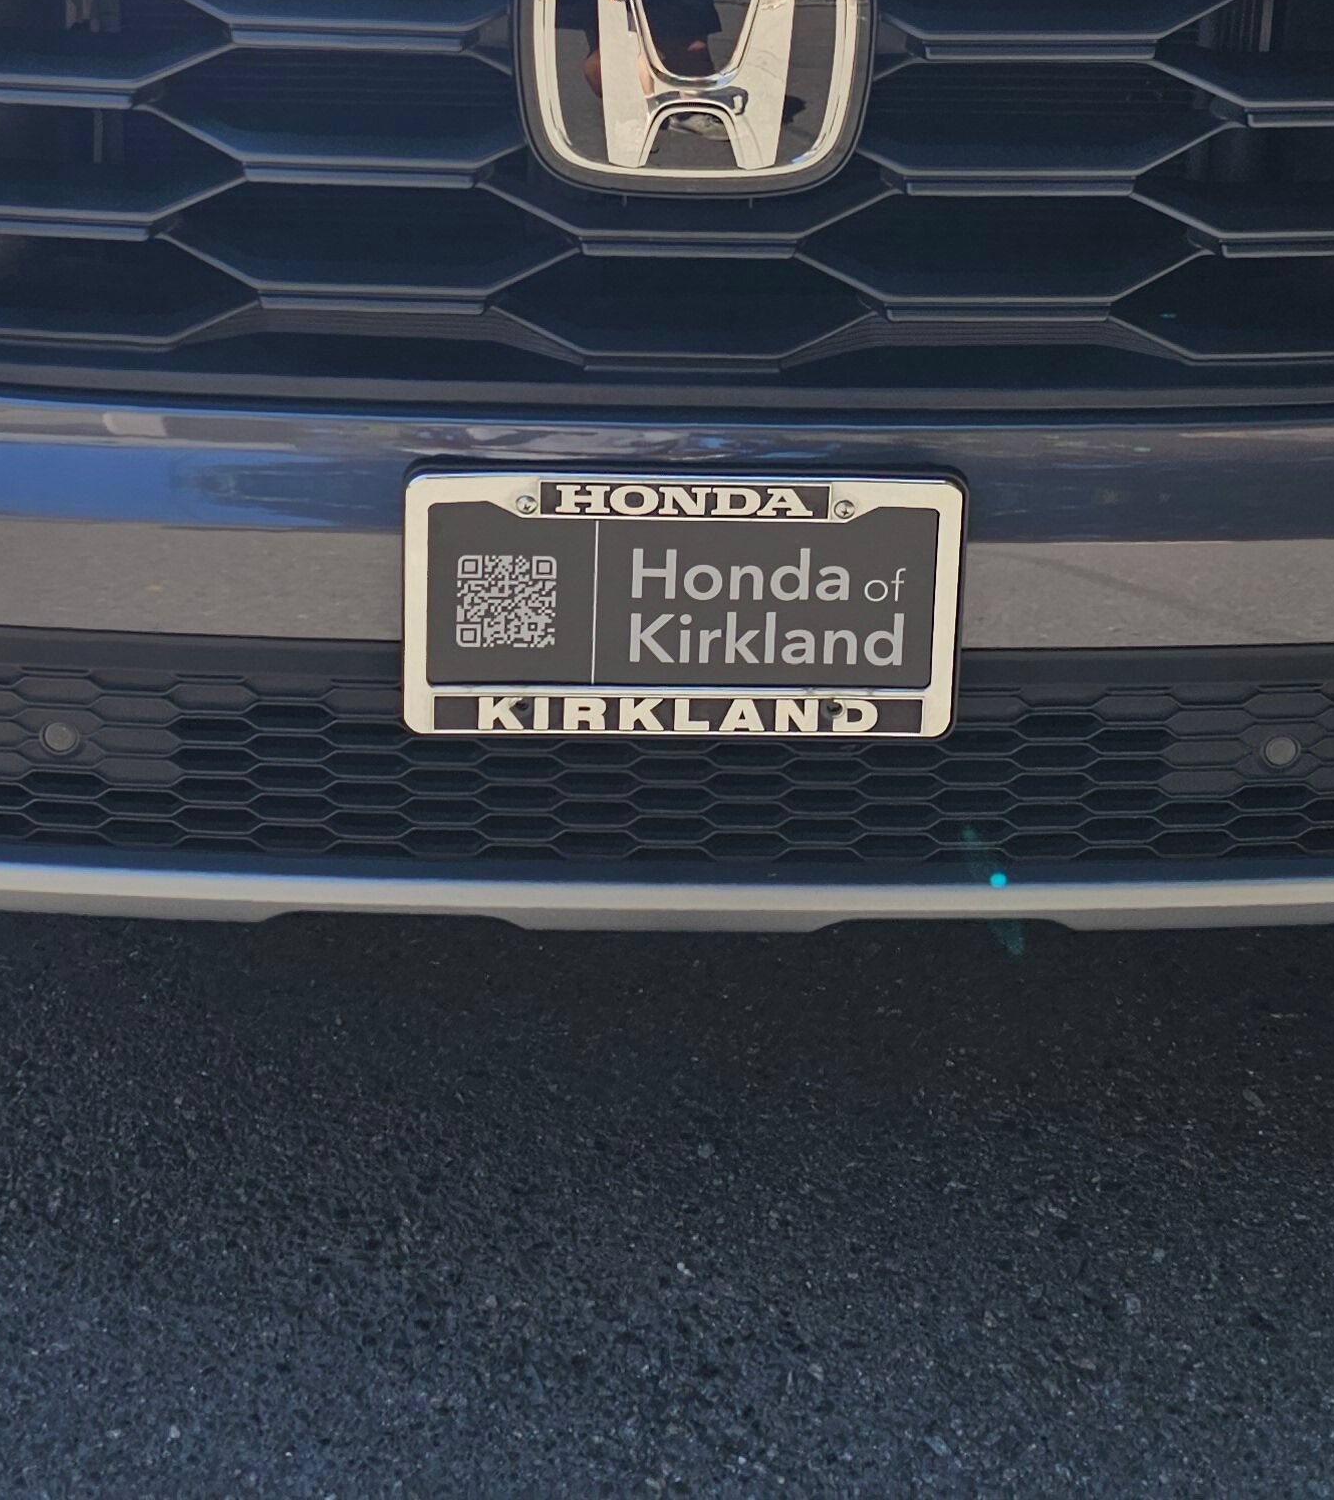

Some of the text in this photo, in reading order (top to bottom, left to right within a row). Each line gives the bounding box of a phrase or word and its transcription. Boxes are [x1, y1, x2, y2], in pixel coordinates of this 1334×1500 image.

[555, 484, 814, 517] HONDA
[631, 547, 907, 602] Honda of
[629, 611, 905, 667] Kirkland
[477, 696, 879, 732] KIRKLAND
